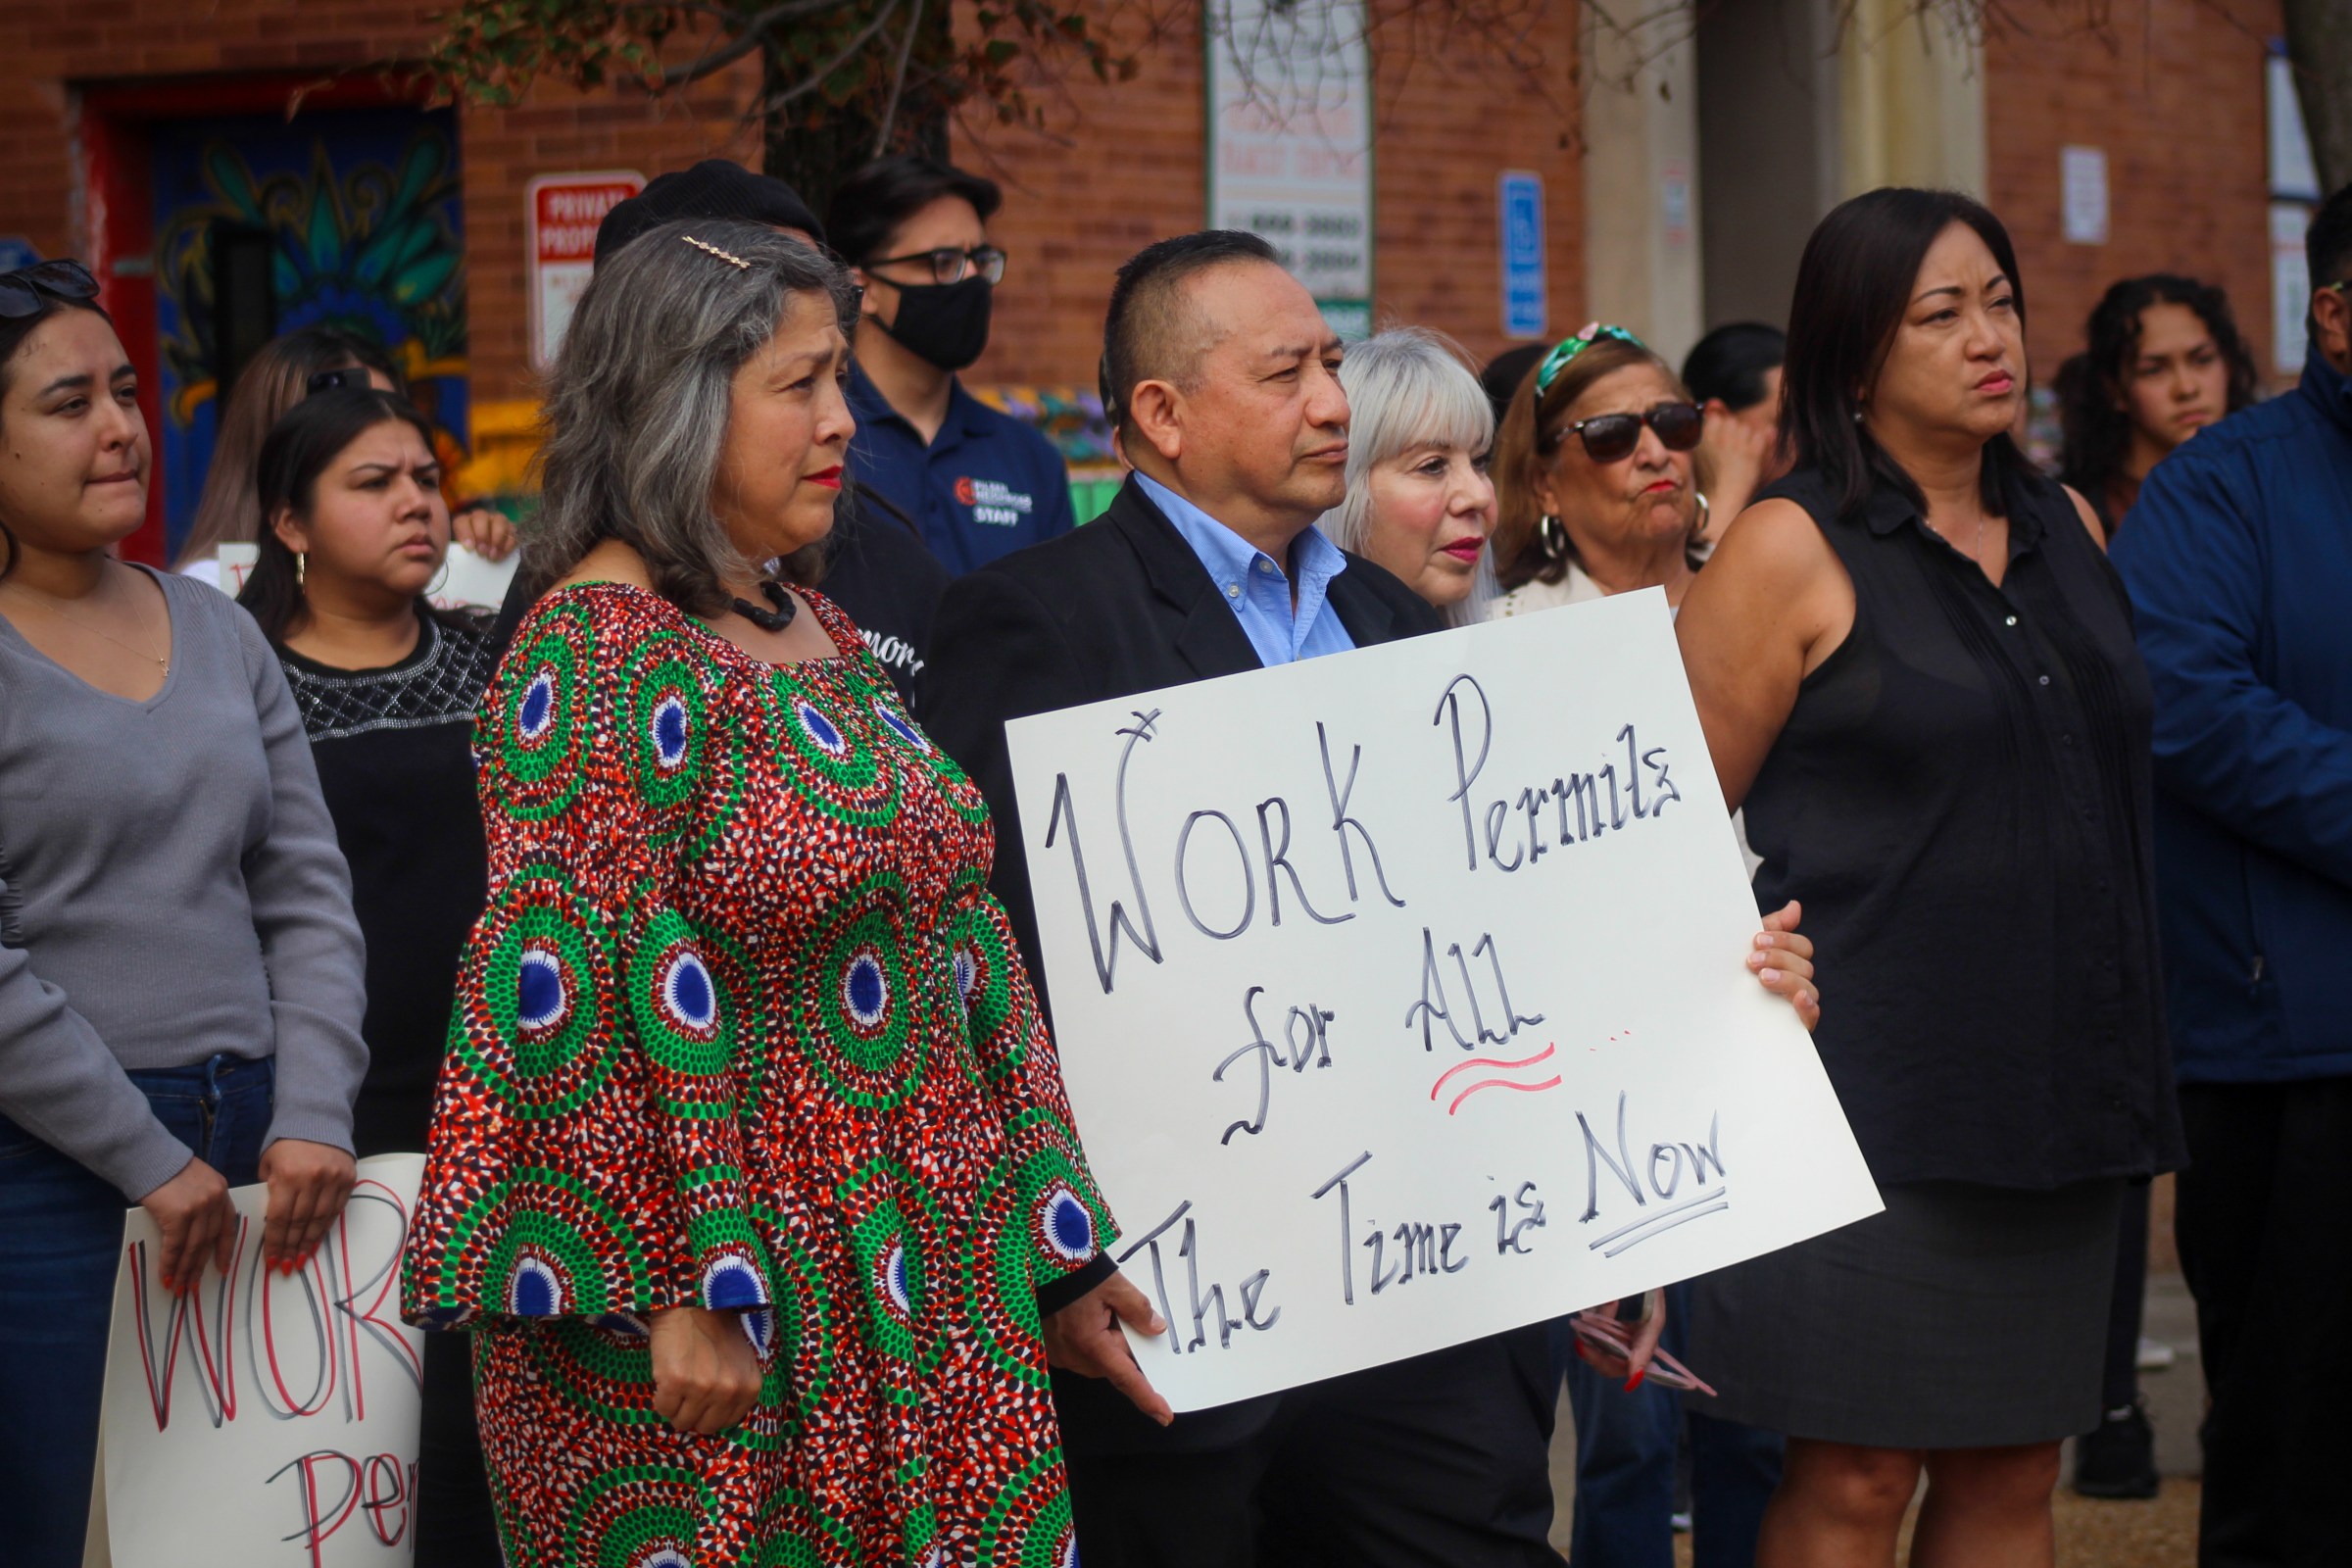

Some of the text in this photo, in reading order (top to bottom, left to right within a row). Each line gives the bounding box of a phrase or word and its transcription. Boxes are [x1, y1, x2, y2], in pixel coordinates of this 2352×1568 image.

[540, 224, 597, 255] PROP
[973, 506, 1018, 526] STAFF
[1045, 674, 1681, 995] WORK Permits
[1213, 986, 1335, 1146] for
[1117, 1201, 1280, 1354] The
[1310, 1151, 1470, 1305] Time
[1488, 1175, 1546, 1256] is
